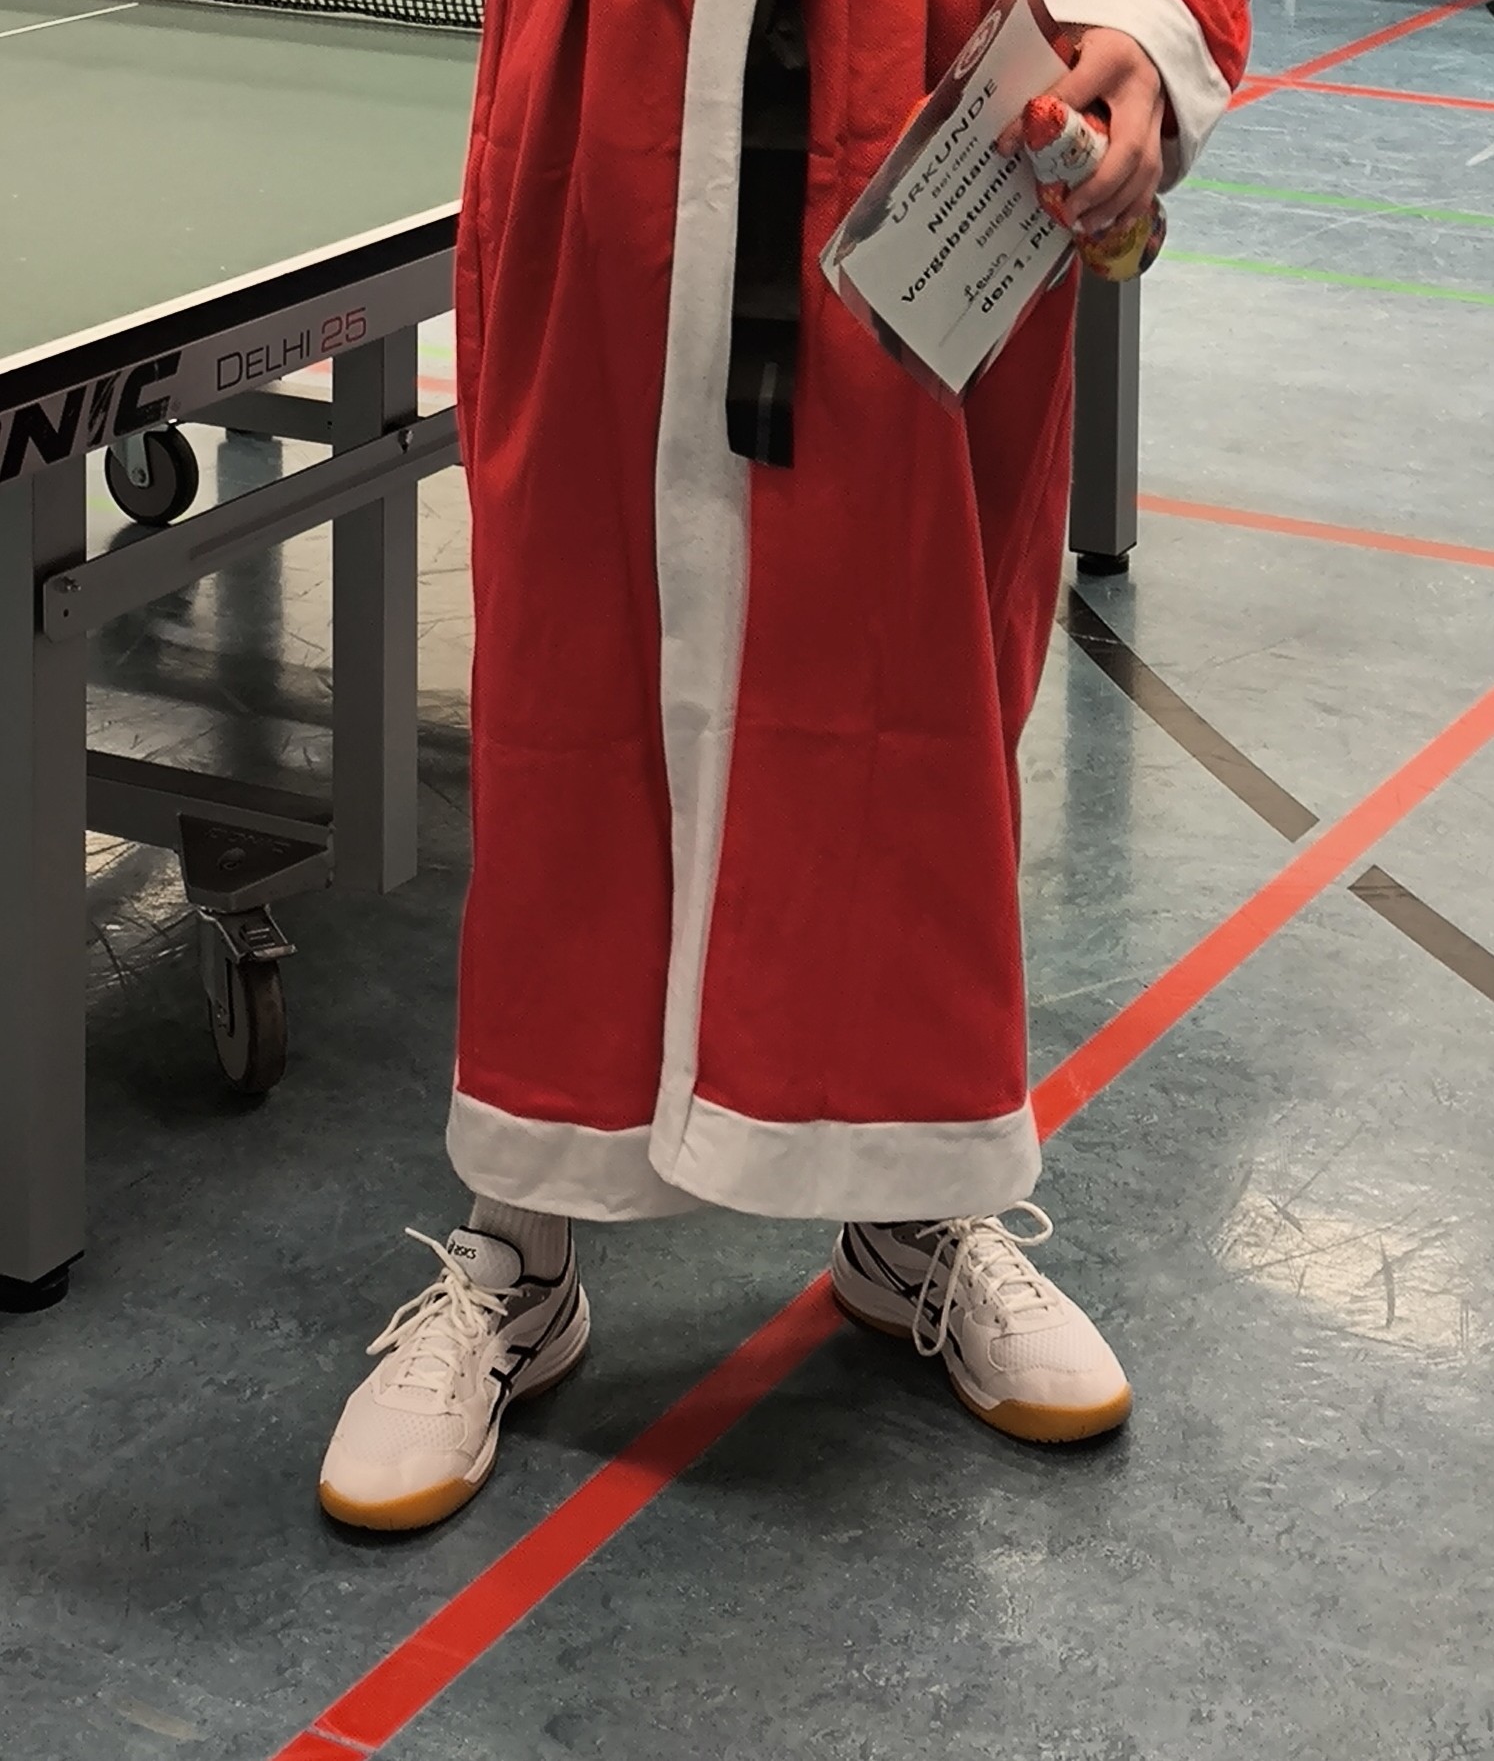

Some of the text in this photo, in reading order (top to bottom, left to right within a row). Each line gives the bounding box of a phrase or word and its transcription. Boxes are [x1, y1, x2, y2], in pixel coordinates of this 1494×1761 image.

[891, 78, 998, 224] URKUNDE
[981, 274, 1014, 314] den
[1013, 255, 1032, 270] 1.
[217, 307, 367, 391] DELHI 25
